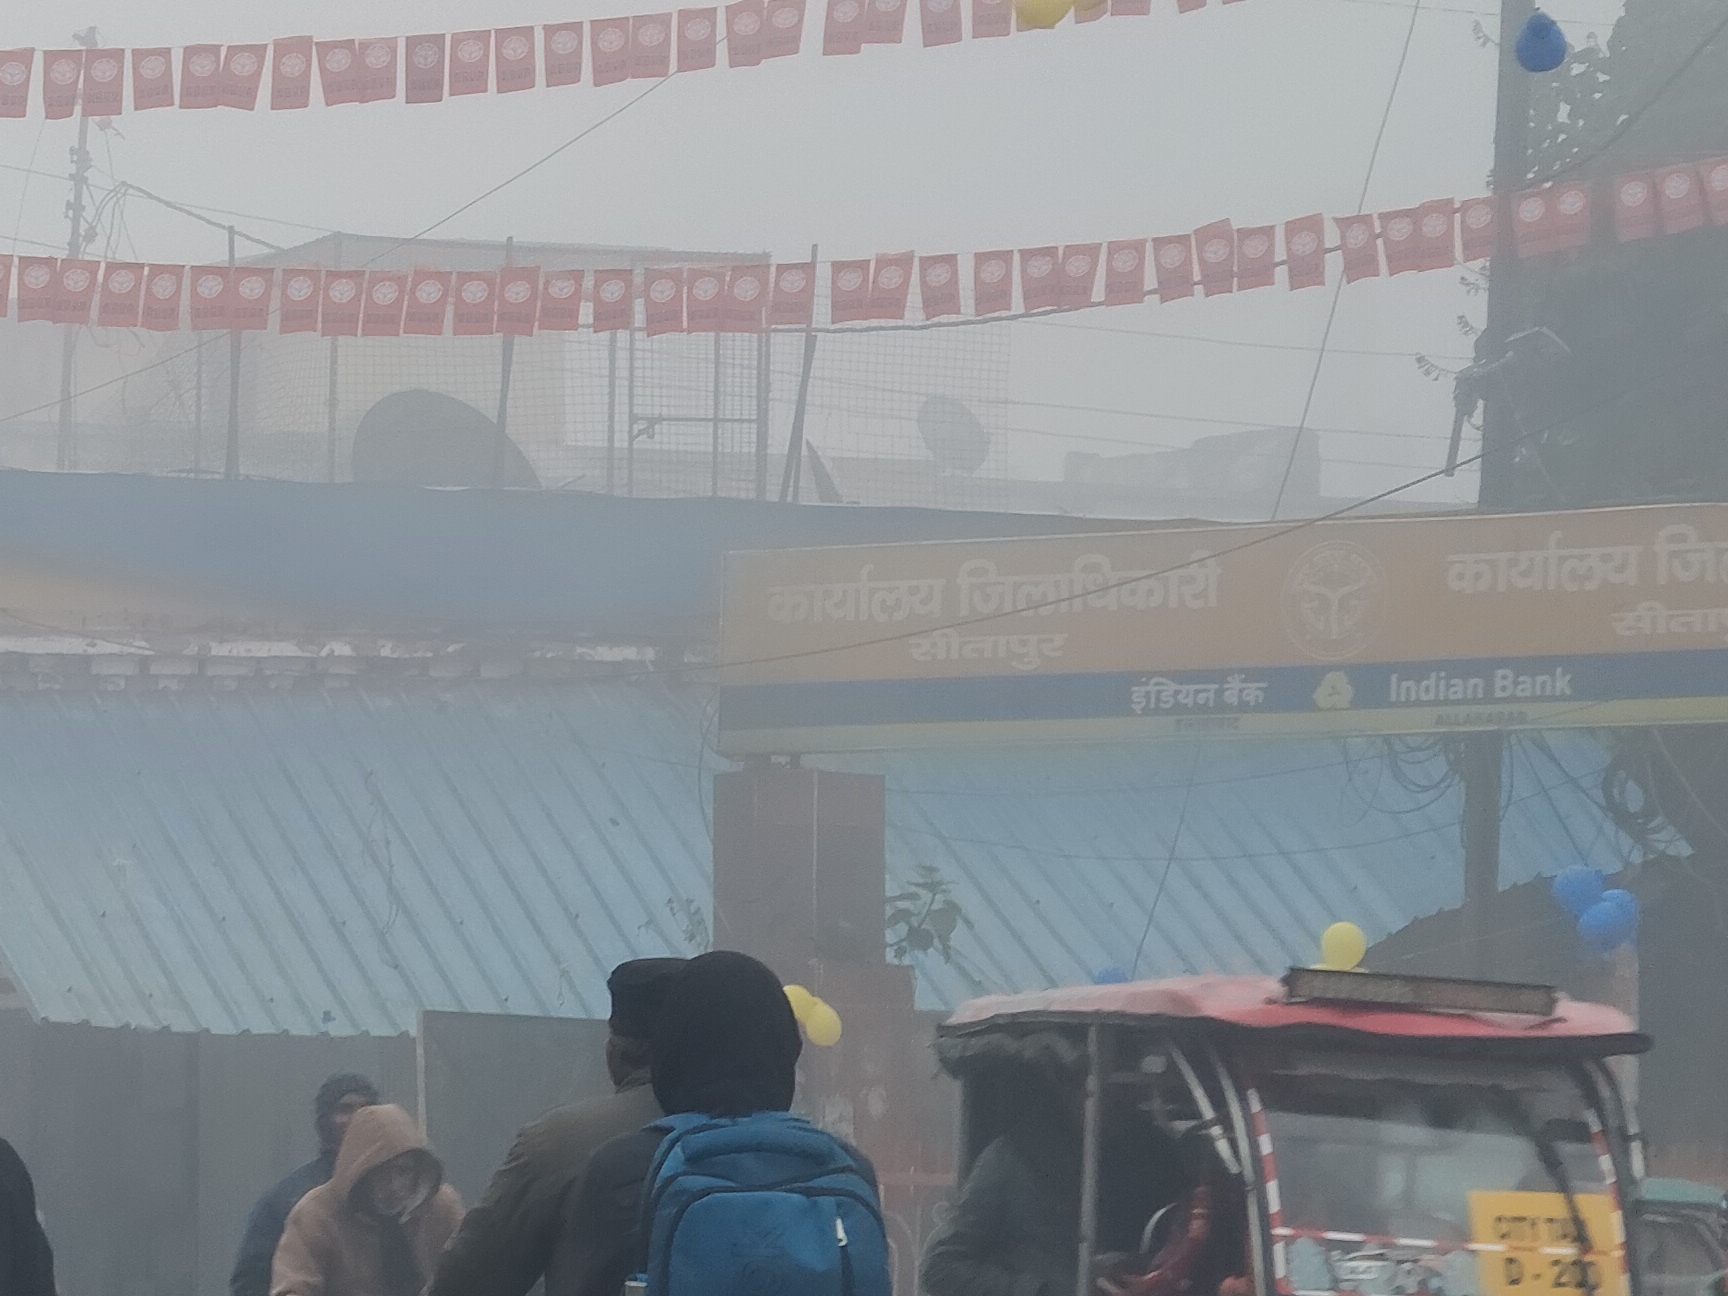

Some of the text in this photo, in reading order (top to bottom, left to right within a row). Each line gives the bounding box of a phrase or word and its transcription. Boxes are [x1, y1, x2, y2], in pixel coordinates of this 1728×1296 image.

[1444, 523, 1728, 593] कार्यालय जि
[767, 549, 1222, 624] कार्यालय जिलाधिकारी
[908, 629, 1069, 670] सीतापुर
[1129, 673, 1267, 713] इंडियन बैंक
[1389, 666, 1571, 703] Indian Bank
